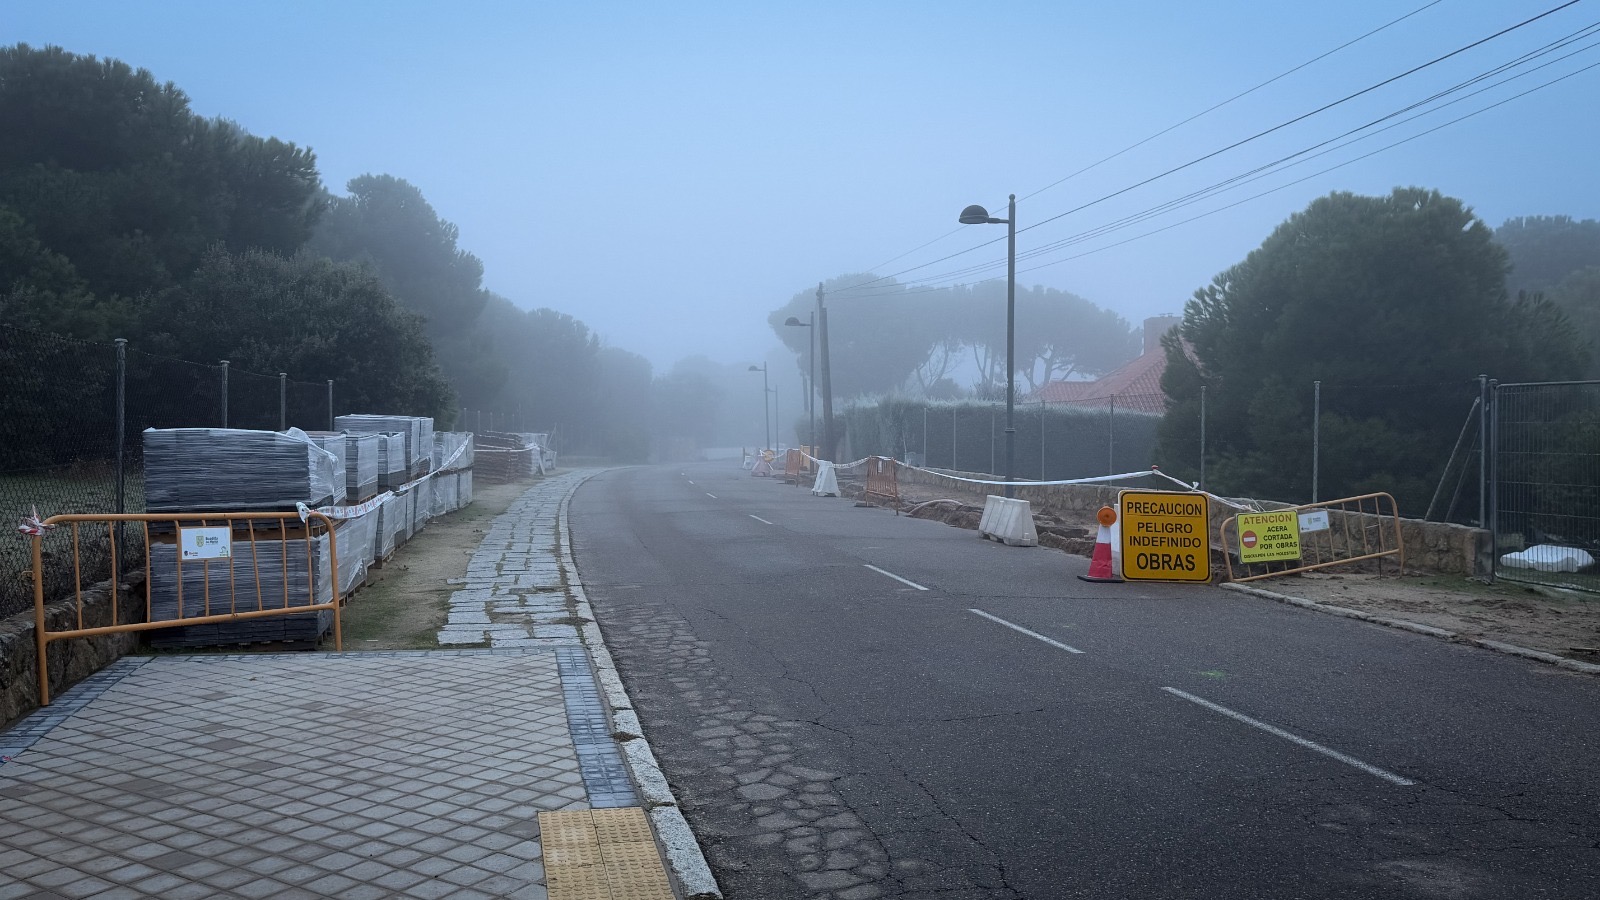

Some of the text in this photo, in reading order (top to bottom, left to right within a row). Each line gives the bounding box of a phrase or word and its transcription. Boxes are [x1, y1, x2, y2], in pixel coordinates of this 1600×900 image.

[1127, 501, 1202, 516] PRECAUCION
[1243, 513, 1292, 525] ATENCIÓN
[1137, 522, 1193, 534] PELIGRO
[1267, 525, 1288, 533] ACERA
[1129, 536, 1202, 548] INDEFINIDO
[1263, 533, 1293, 541] CORTADA
[1275, 541, 1298, 549] OBRAS
[1136, 552, 1196, 572] OBRAS
